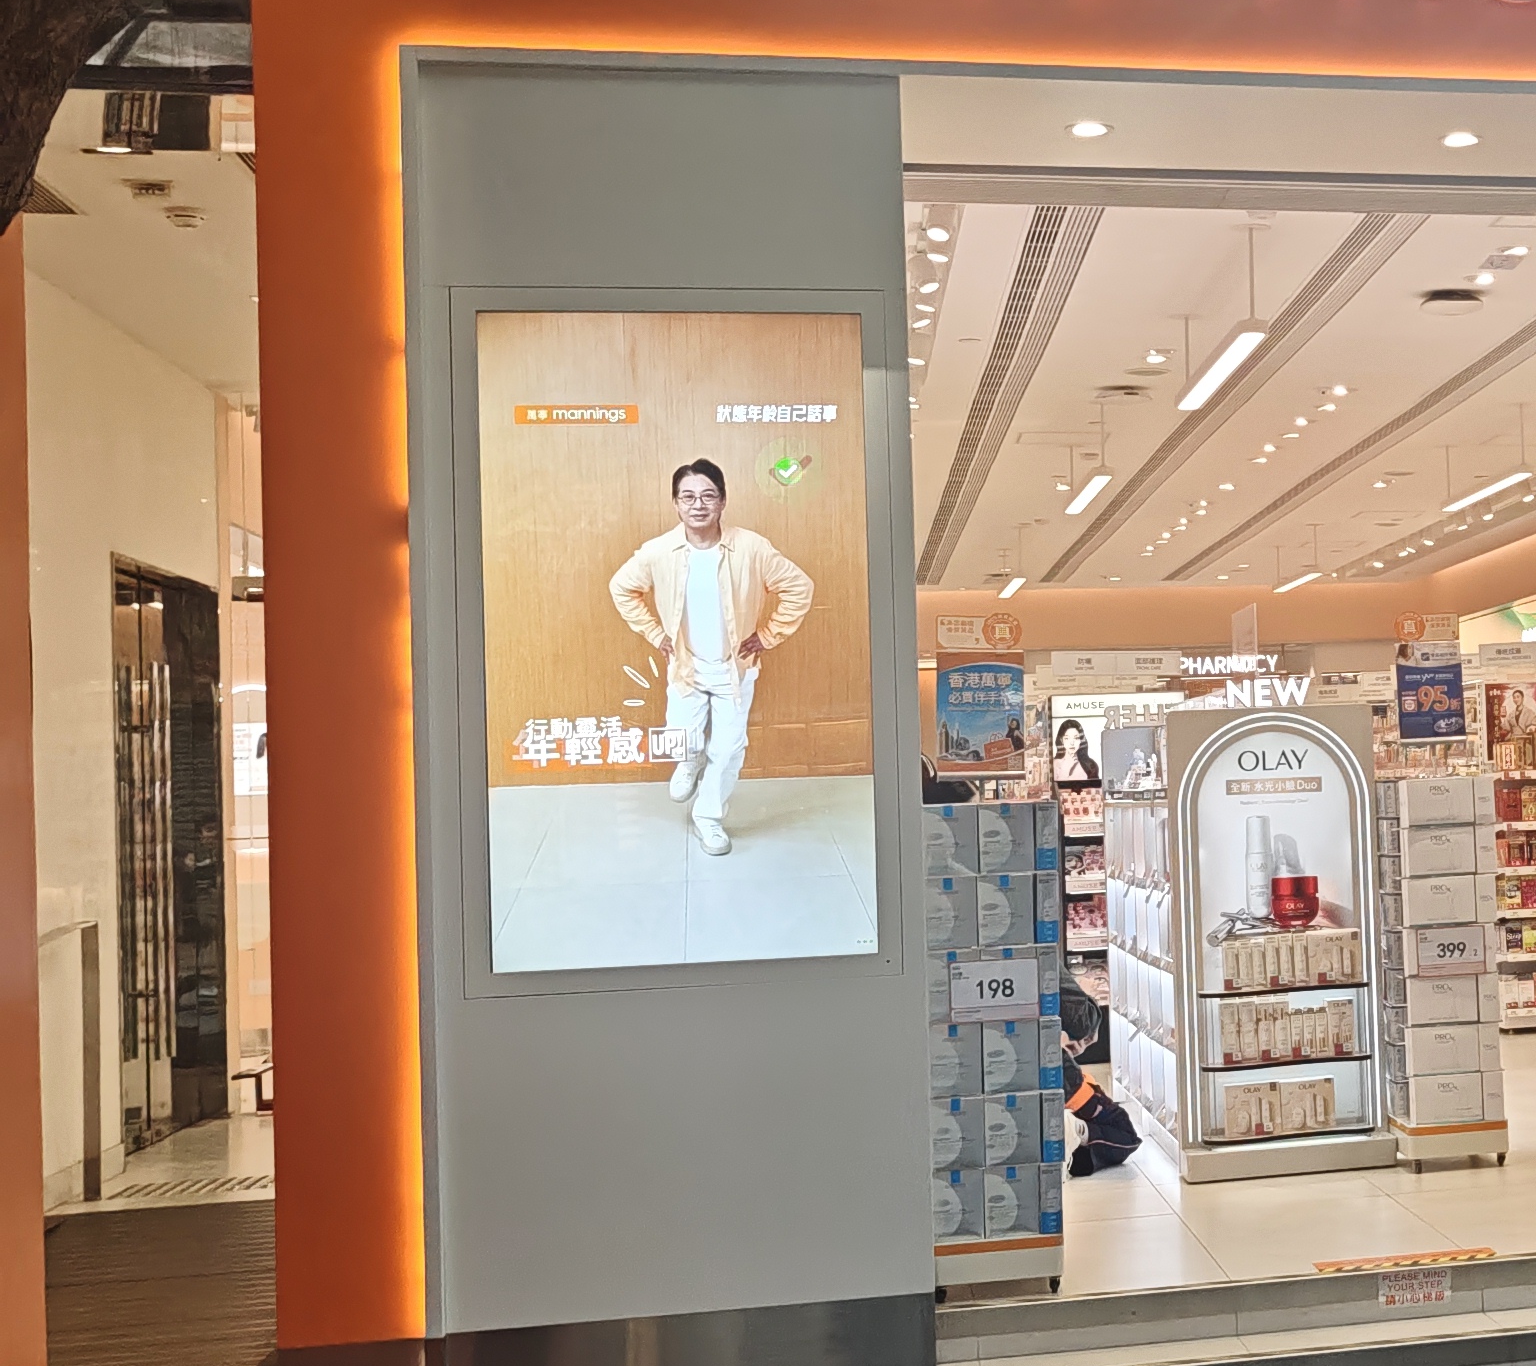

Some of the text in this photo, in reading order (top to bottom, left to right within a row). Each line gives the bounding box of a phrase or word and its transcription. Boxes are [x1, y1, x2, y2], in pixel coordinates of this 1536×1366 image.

[552, 406, 626, 423] mannings
[1226, 677, 1311, 708] NEW
[1417, 685, 1450, 712] 95
[1066, 701, 1105, 710] AMUSE
[522, 728, 645, 767] 年輕感
[1238, 749, 1309, 771] OLAY
[1326, 935, 1344, 943] OLAY
[1436, 942, 1467, 958] 399
[976, 978, 1015, 999] 198
[1243, 1086, 1262, 1094] OLAY
[1382, 1269, 1447, 1283] PLEASE MIND
[1387, 1280, 1443, 1292] YOUR STEP
